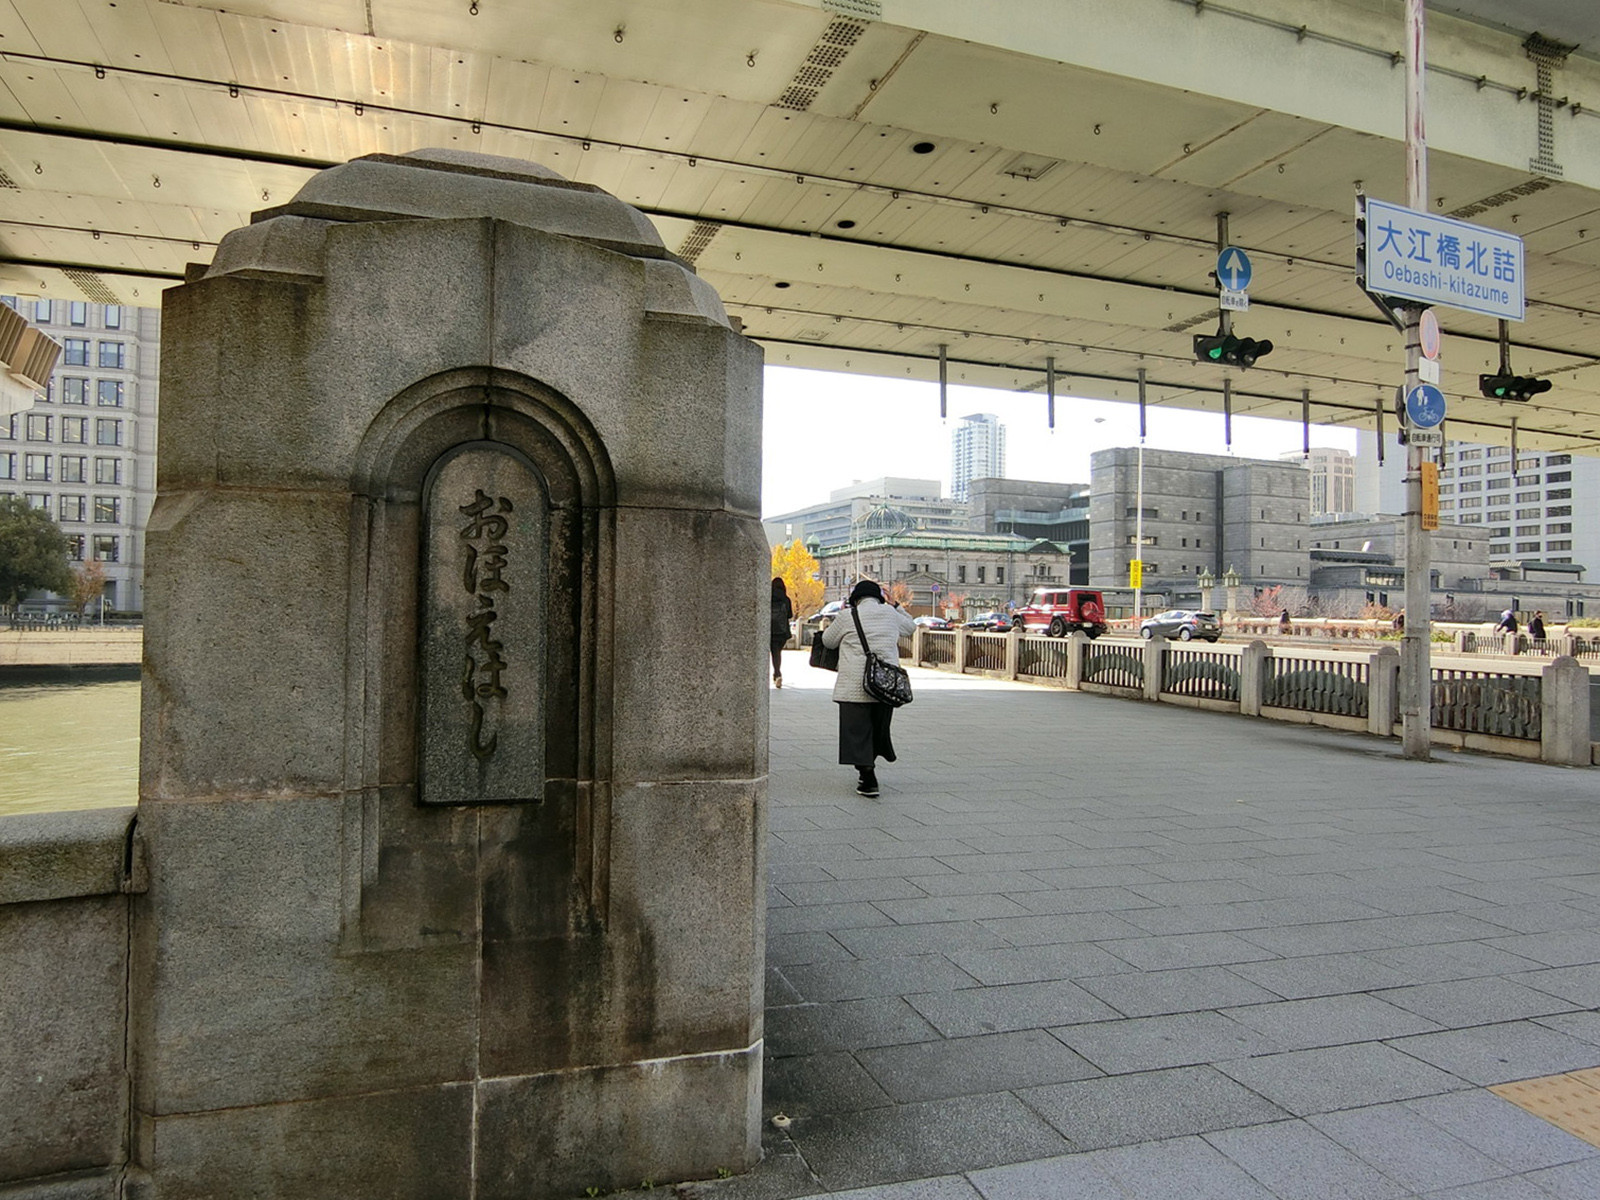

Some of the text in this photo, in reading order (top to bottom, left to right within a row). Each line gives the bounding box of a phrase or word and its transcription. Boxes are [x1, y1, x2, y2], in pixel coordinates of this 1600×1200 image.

[1377, 220, 1515, 283] 大江橋北詰
[1384, 260, 1509, 305] Oebashi-kitazume
